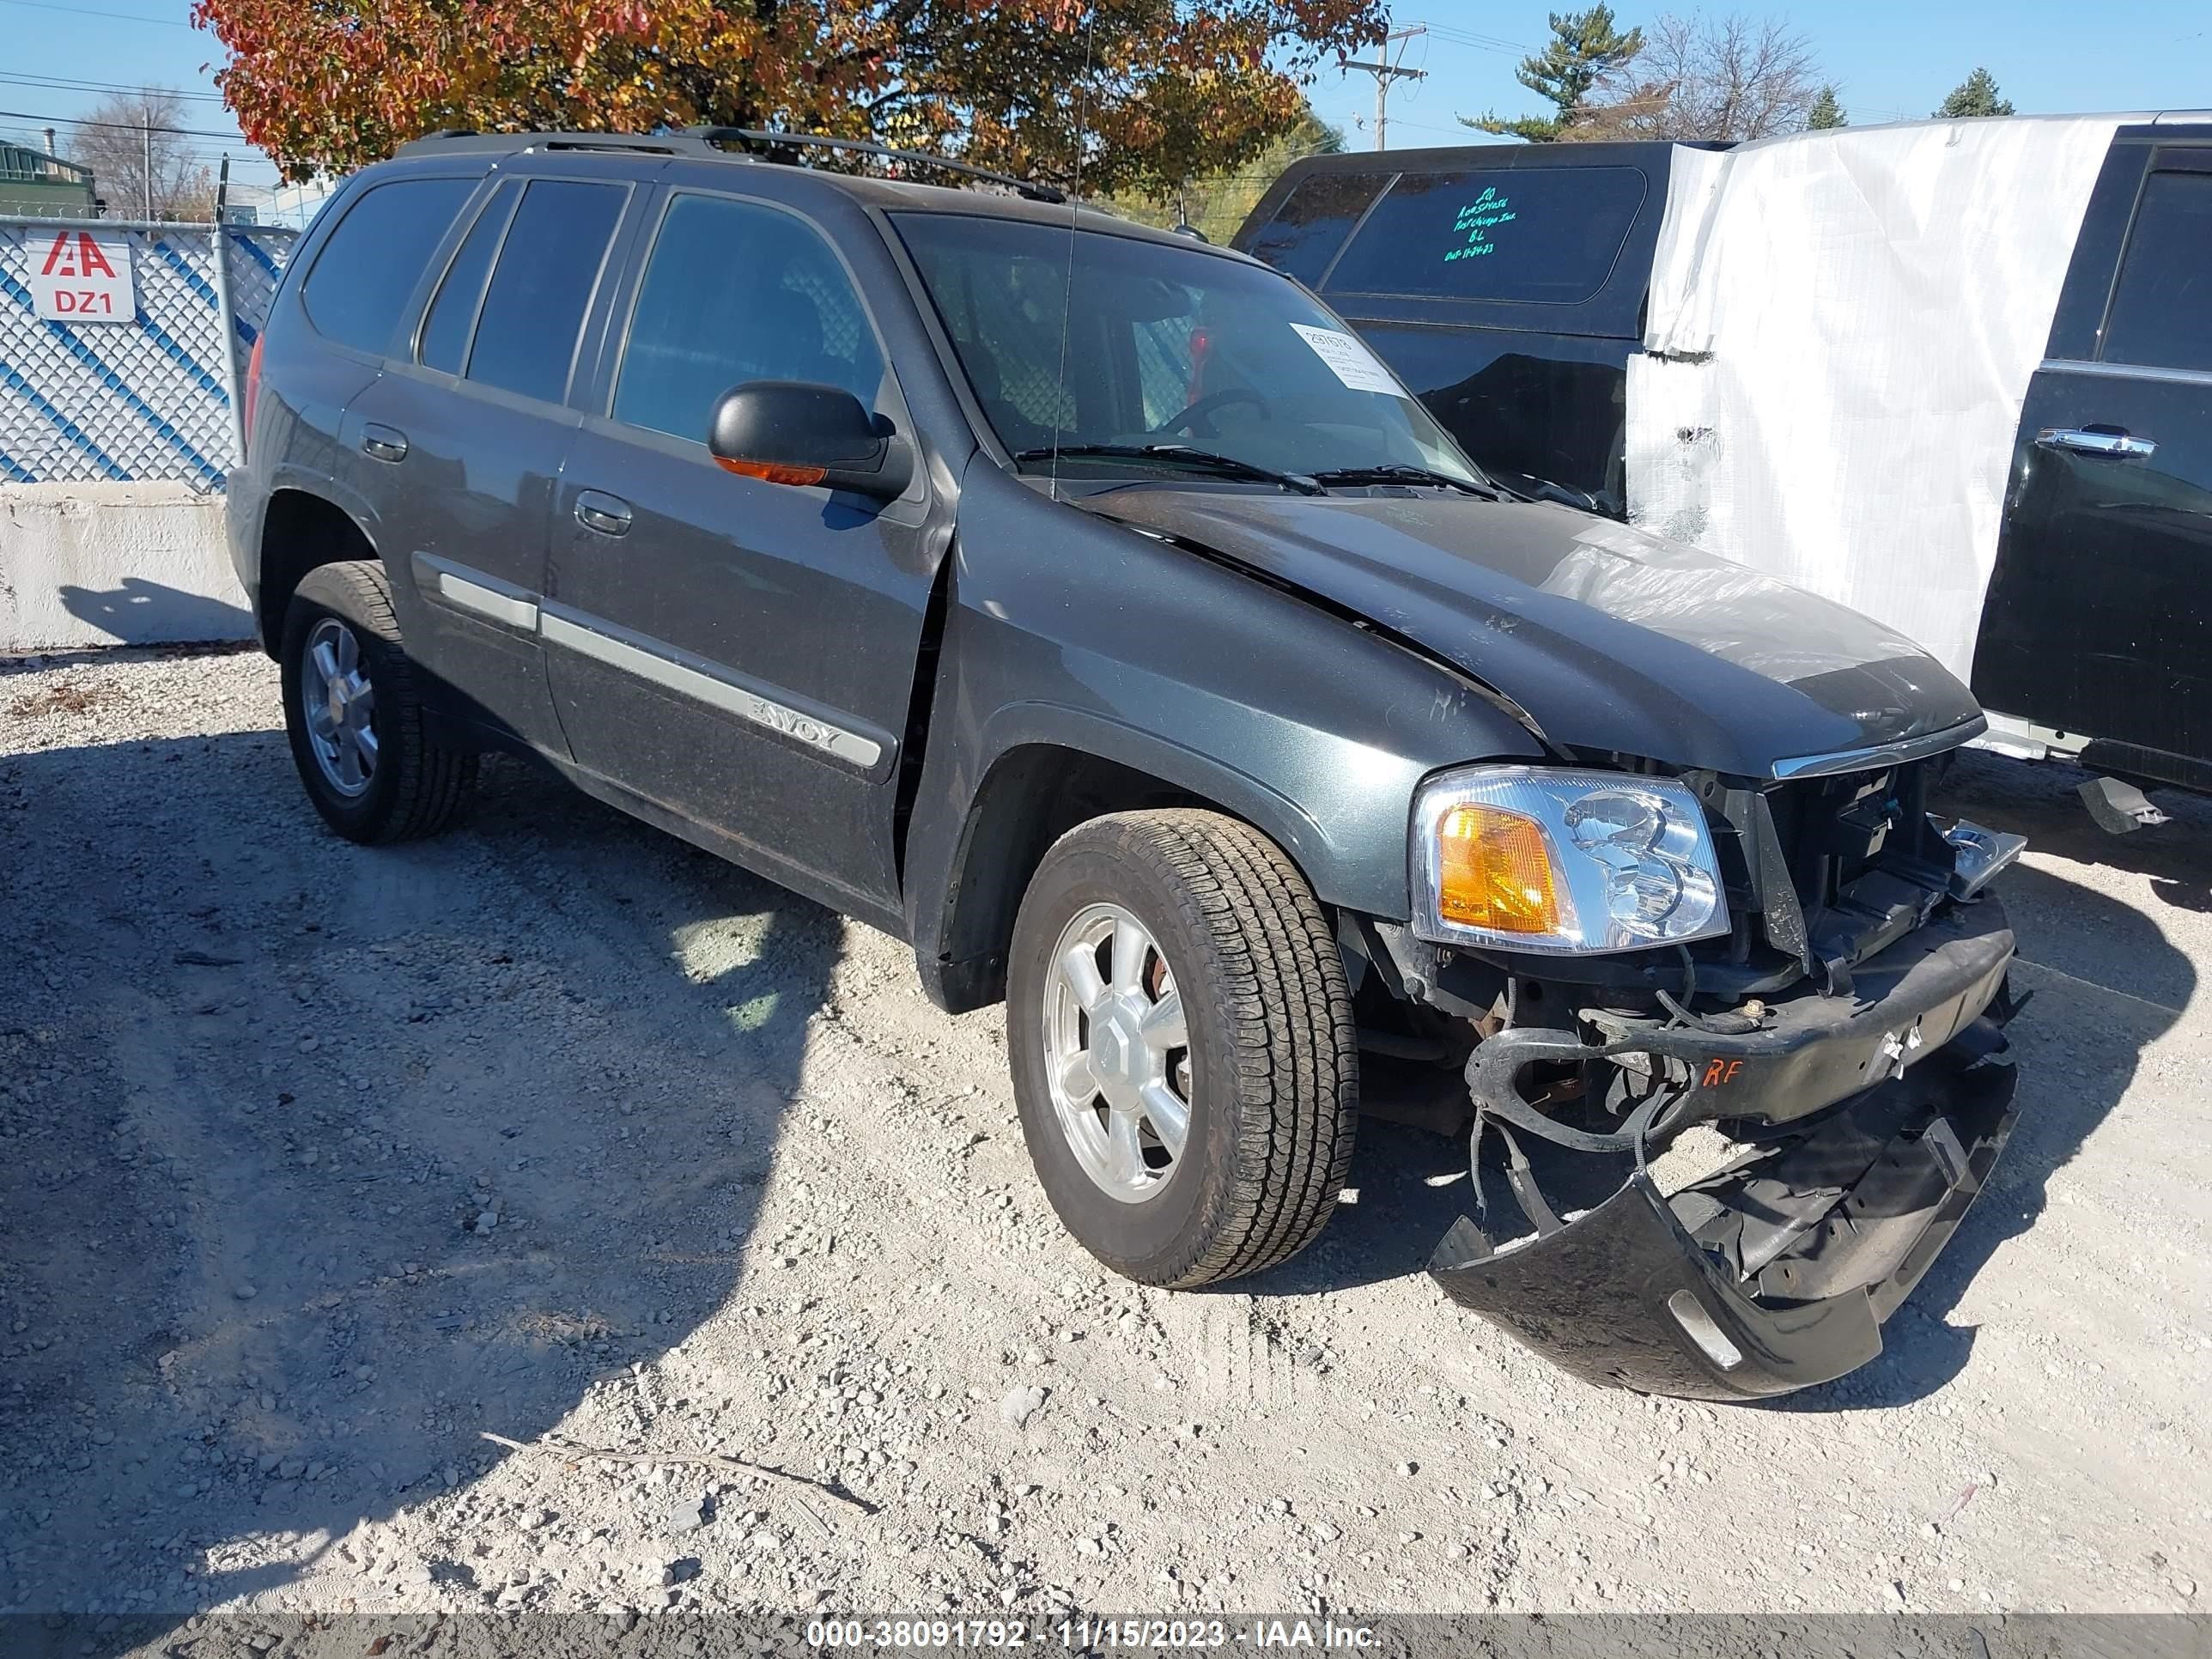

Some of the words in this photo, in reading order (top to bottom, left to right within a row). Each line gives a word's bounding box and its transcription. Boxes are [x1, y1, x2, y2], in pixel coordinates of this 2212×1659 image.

[54, 289, 112, 314] DZ1
[752, 697, 842, 749] ENVOY
[1703, 1058, 1744, 1087] RF
